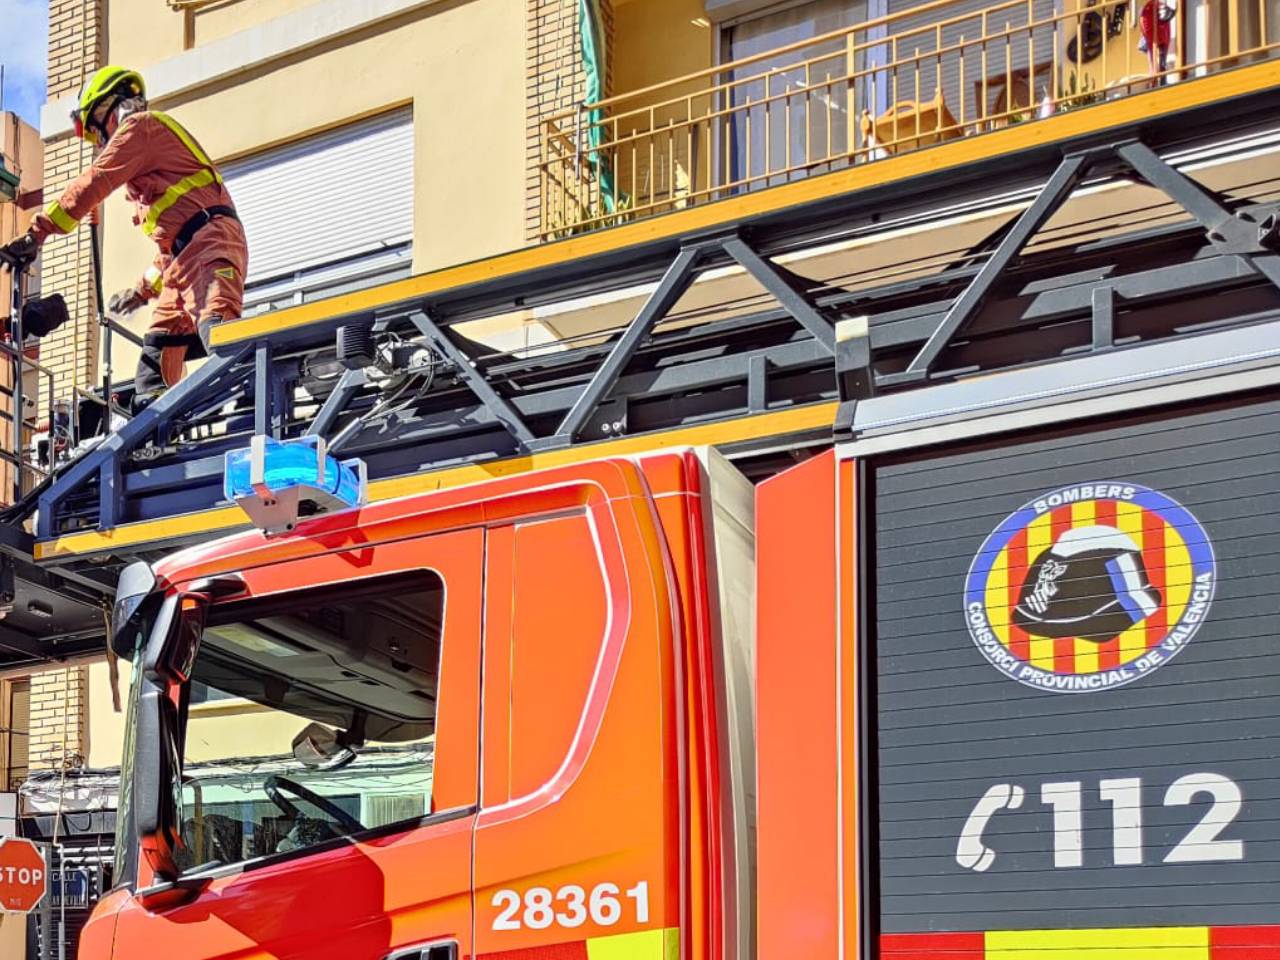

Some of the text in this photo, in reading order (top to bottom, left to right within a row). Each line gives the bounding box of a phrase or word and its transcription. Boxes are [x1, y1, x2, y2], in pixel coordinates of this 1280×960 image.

[1033, 484, 1137, 514] BOMBERS
[967, 571, 1212, 690] CONSORCI PROVINCIAL DE VALENCIA
[1040, 772, 1244, 868] 112
[491, 881, 649, 931] 28361
